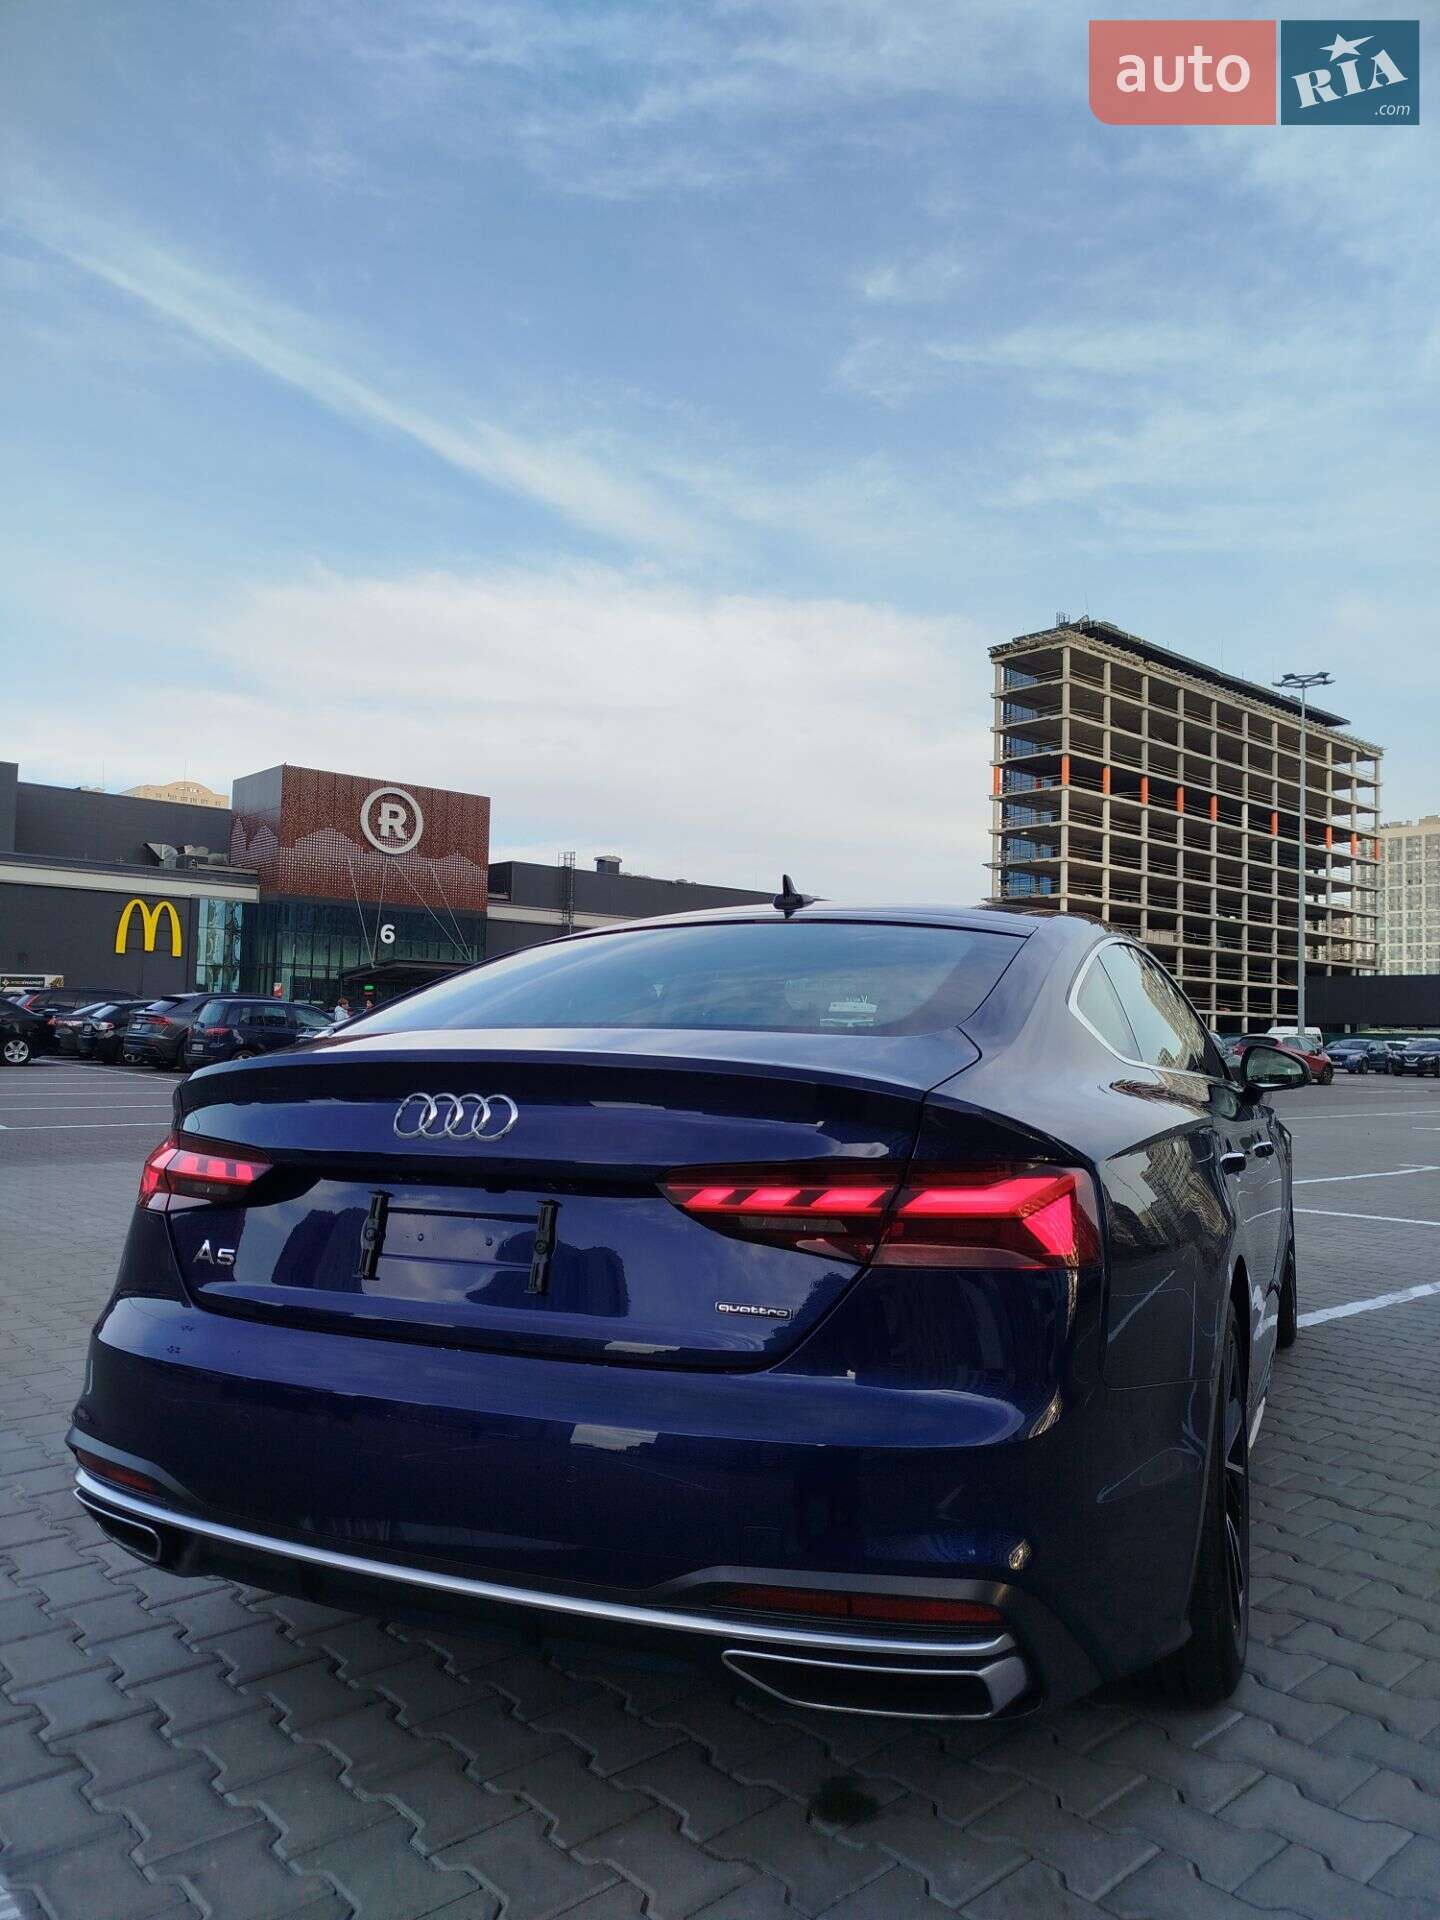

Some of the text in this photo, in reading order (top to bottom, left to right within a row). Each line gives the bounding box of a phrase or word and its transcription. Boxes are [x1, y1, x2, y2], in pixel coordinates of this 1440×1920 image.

[378, 802, 407, 839] R
[380, 924, 395, 944] 6
[192, 1239, 235, 1265] A5
[718, 1303, 788, 1317] quattro
